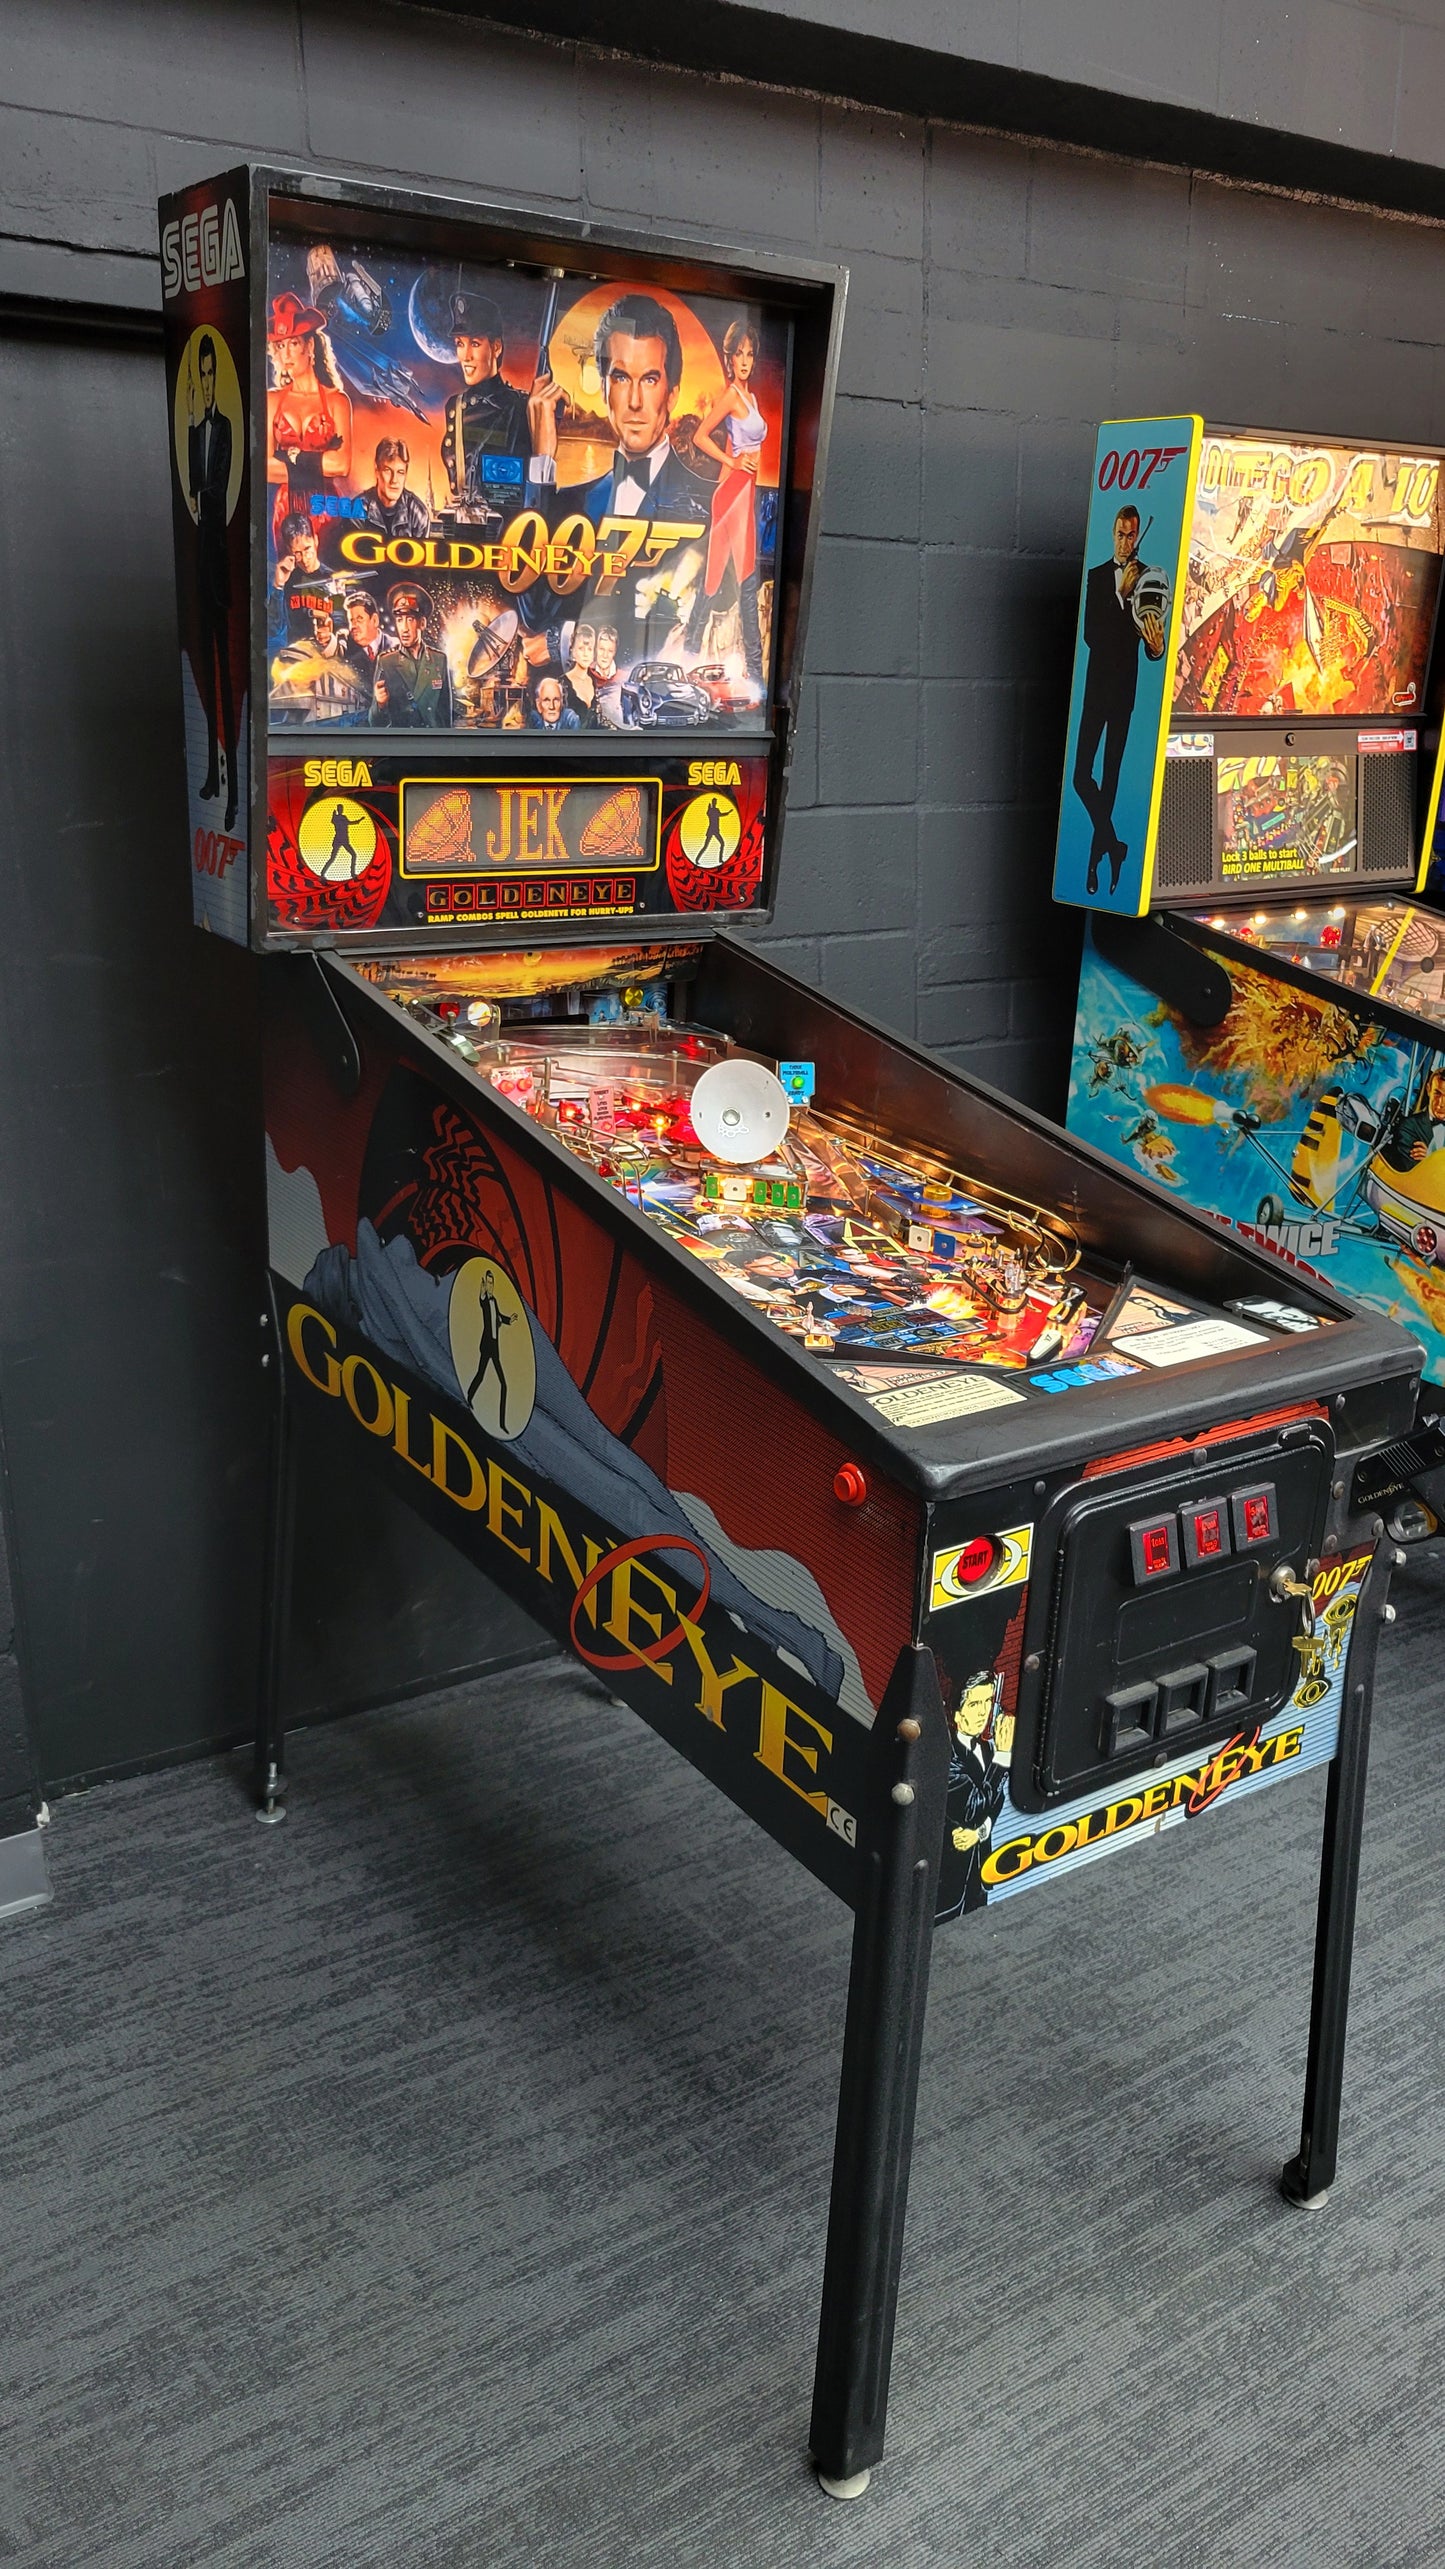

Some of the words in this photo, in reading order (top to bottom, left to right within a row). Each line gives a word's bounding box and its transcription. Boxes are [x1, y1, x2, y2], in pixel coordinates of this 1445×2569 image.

[162, 198, 246, 299] SEGA
[1098, 446, 1188, 491] 007
[310, 494, 368, 520] SEGA
[340, 531, 628, 577] GOLDENEYE
[499, 511, 706, 597] 007
[304, 760, 373, 787] SEGA
[688, 762, 742, 786] SEGA
[486, 788, 572, 862] JEK
[194, 827, 245, 879] 007
[1222, 851, 1241, 863] Lock
[1242, 850, 1248, 860] 3
[1249, 849, 1267, 861] balls
[1269, 849, 1277, 860] to
[1279, 848, 1297, 859] start
[1222, 863, 1243, 875] BIRD
[1244, 861, 1262, 873] ONE
[1262, 859, 1304, 873] MULTIBALL
[430, 883, 632, 906] GOLDENEYE
[428, 914, 454, 923] RAMP
[456, 913, 493, 922] COMBOS
[495, 911, 519, 920] SPELL
[521, 909, 569, 919] GOLDENEYE
[570, 908, 587, 917] FOR
[588, 906, 634, 916] HURRY-UPS
[1240, 1220, 1343, 1257] WICE
[872, 1376, 987, 1407] OLDENEYE
[1029, 1360, 1142, 1394] SEGA
[1357, 1482, 1405, 1504] GOLDENEYE
[287, 1302, 833, 1820] GOLDENEYE
[961, 1549, 989, 1570] START
[1311, 1554, 1373, 1601] 007
[980, 1726, 1305, 1885] GOLDENEYE
[830, 1807, 854, 1842] CE
